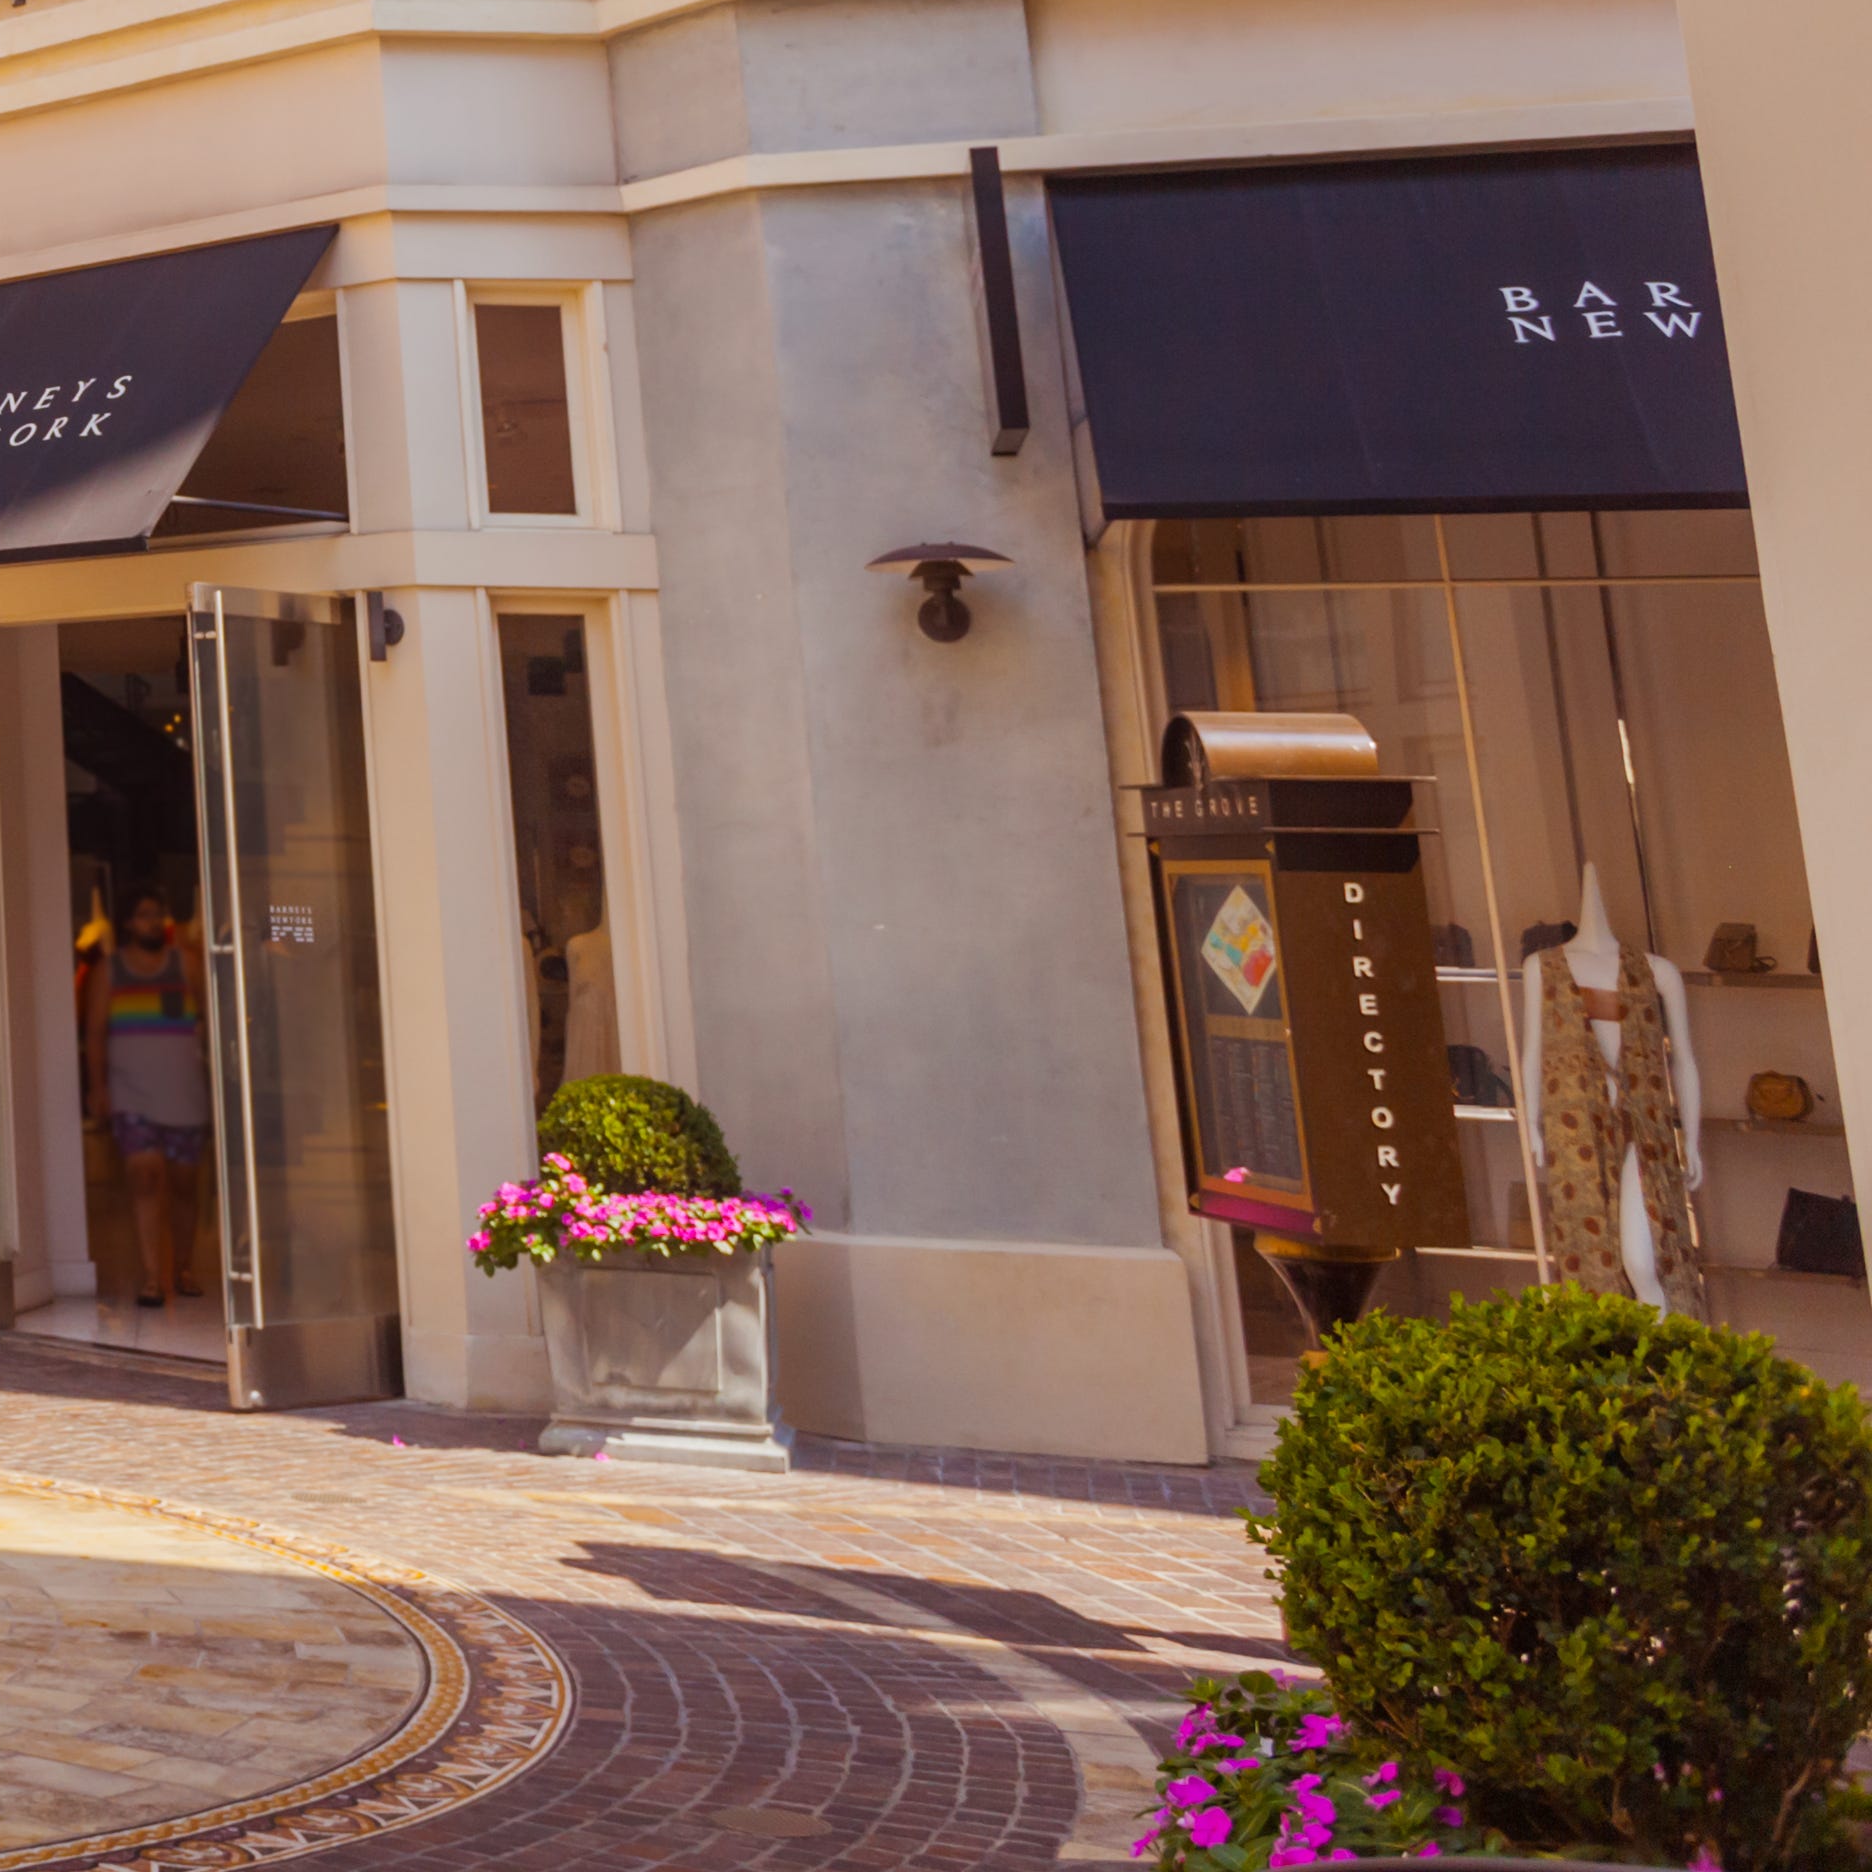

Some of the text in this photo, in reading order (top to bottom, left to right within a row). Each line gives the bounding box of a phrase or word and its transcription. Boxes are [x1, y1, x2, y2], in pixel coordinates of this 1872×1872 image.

[1507, 311, 1702, 344] NEW
[1150, 796, 1259, 819] THE GROVE
[1343, 882, 1403, 1207] DIRECTORY
